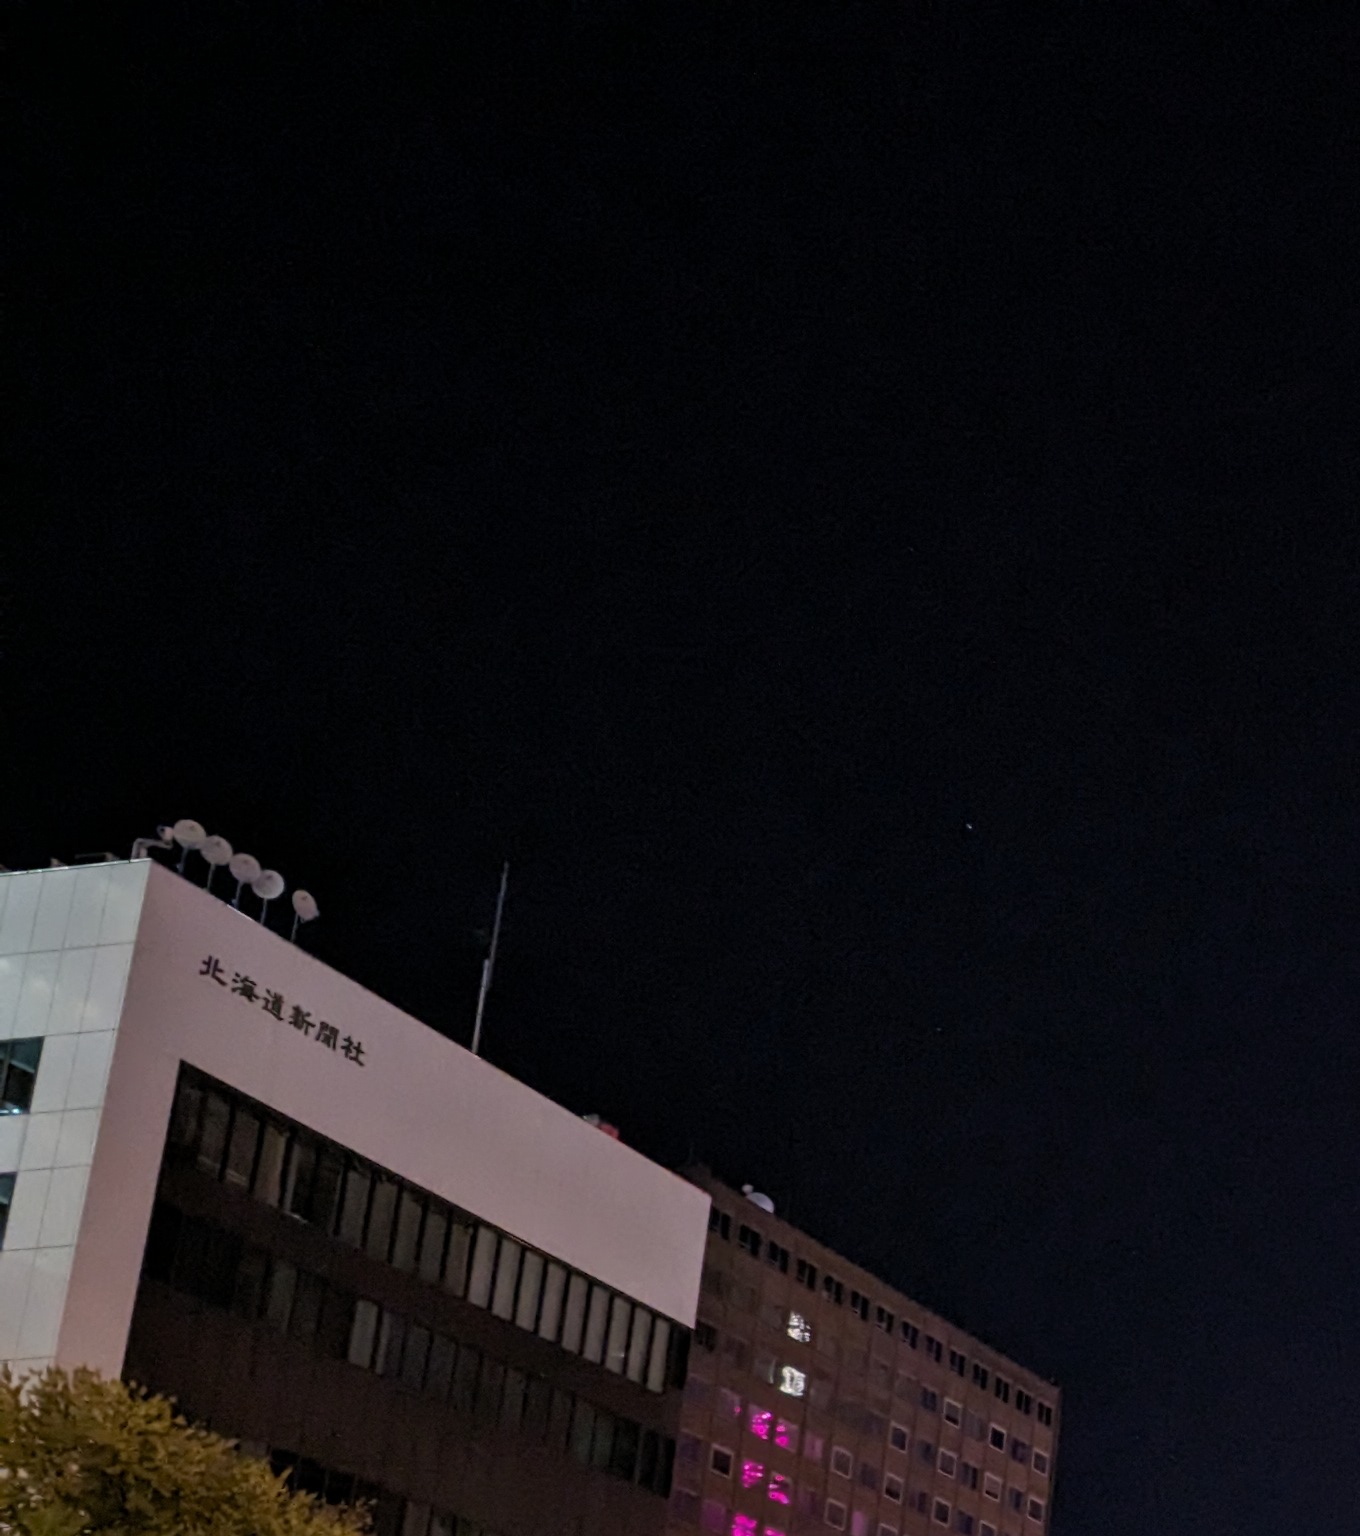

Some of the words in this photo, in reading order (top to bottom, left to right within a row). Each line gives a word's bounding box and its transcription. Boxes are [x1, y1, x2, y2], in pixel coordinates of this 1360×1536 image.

[199, 955, 365, 1067] 北海道新聞社
